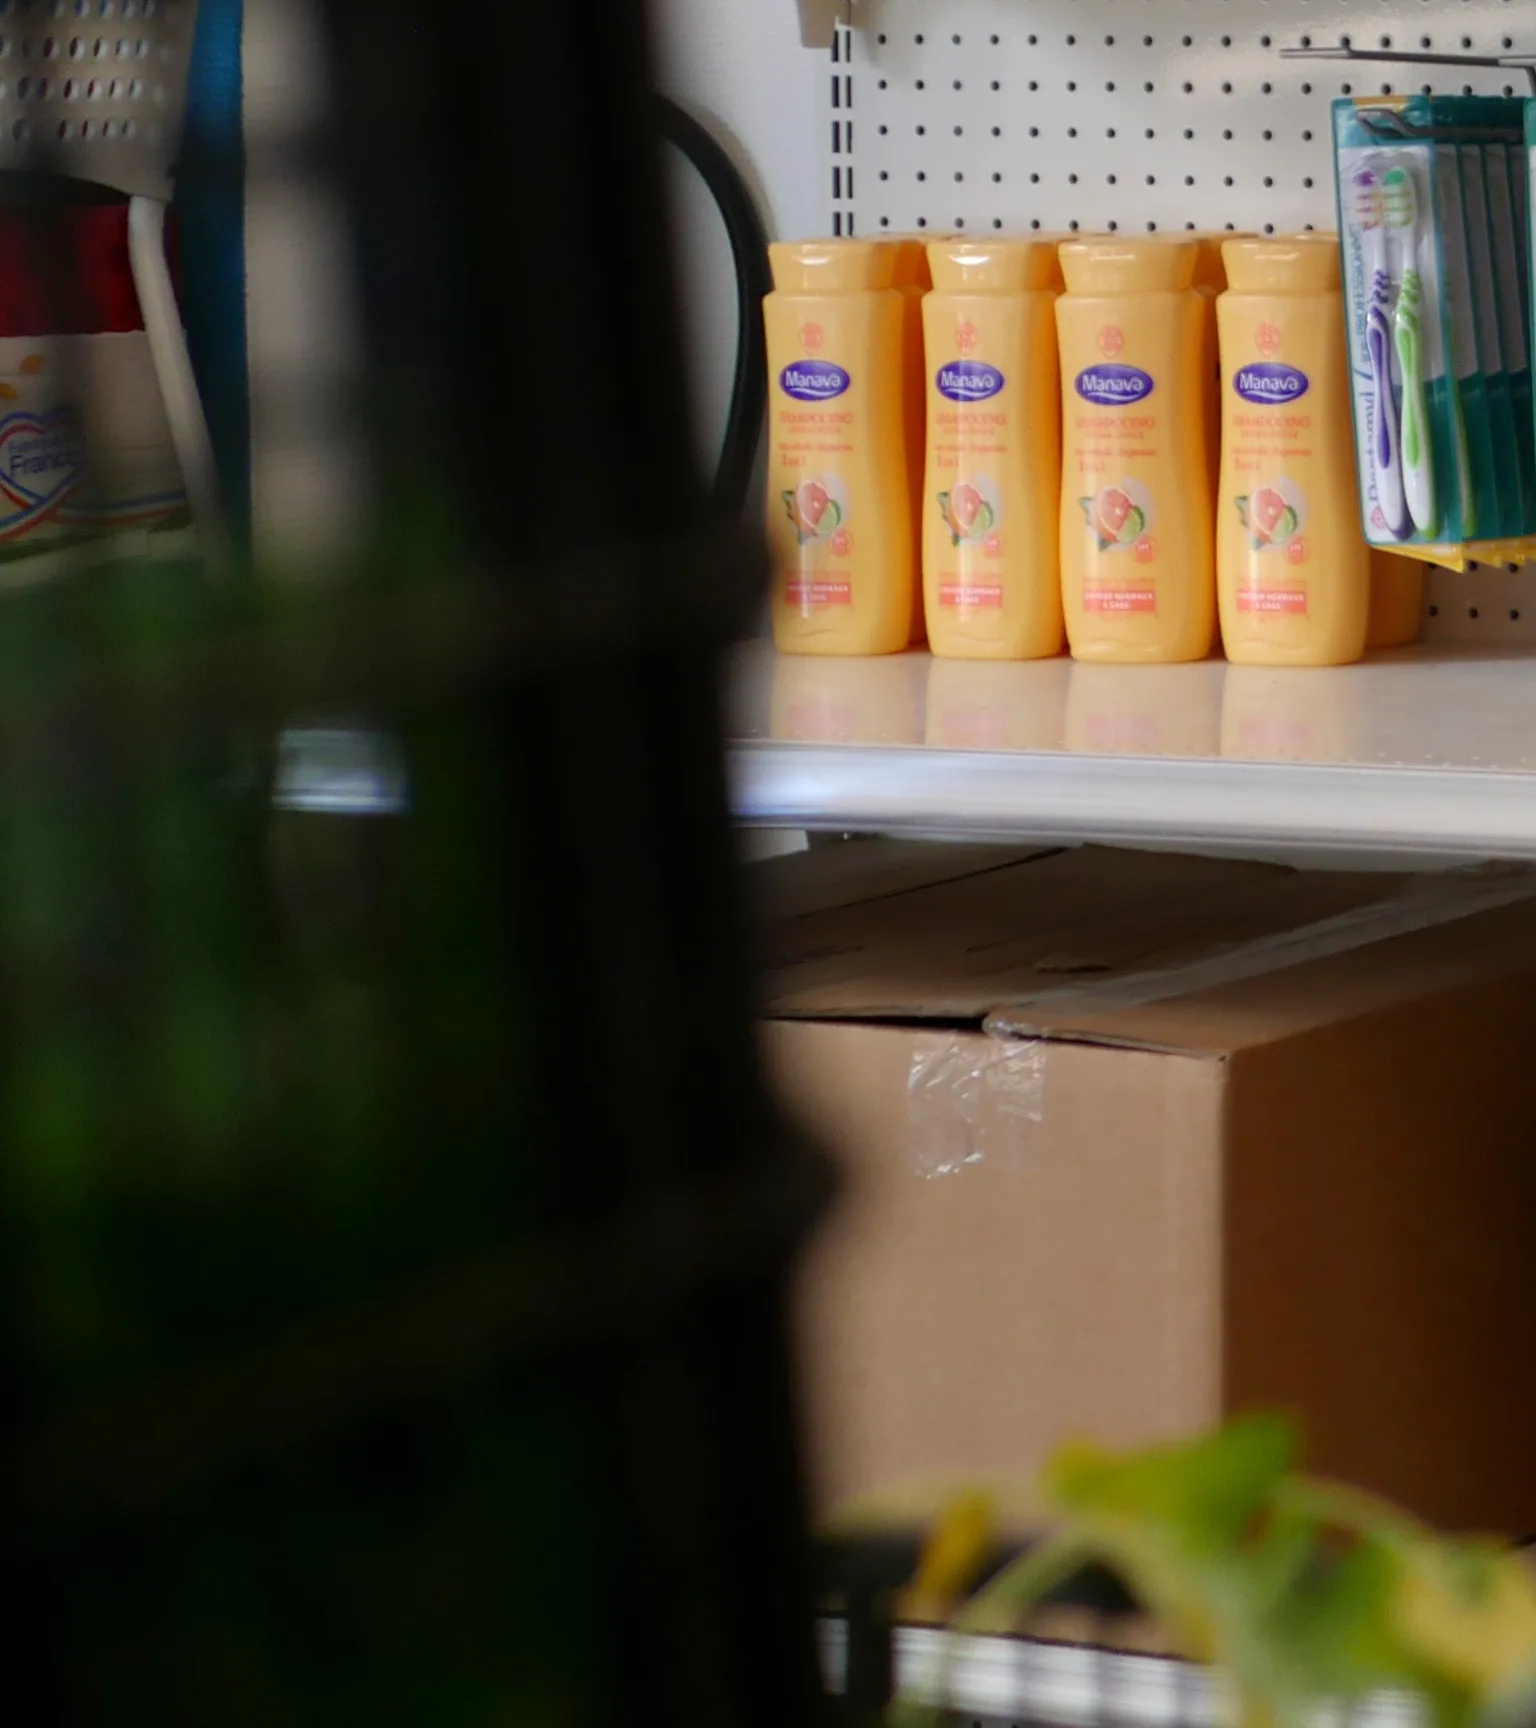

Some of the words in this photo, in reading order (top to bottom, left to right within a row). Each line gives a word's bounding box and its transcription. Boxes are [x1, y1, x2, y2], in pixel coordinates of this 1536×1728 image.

[785, 371, 843, 388] Manava
[939, 372, 996, 389] Manava
[1081, 376, 1144, 393] Manava
[1239, 373, 1300, 391] Manava
